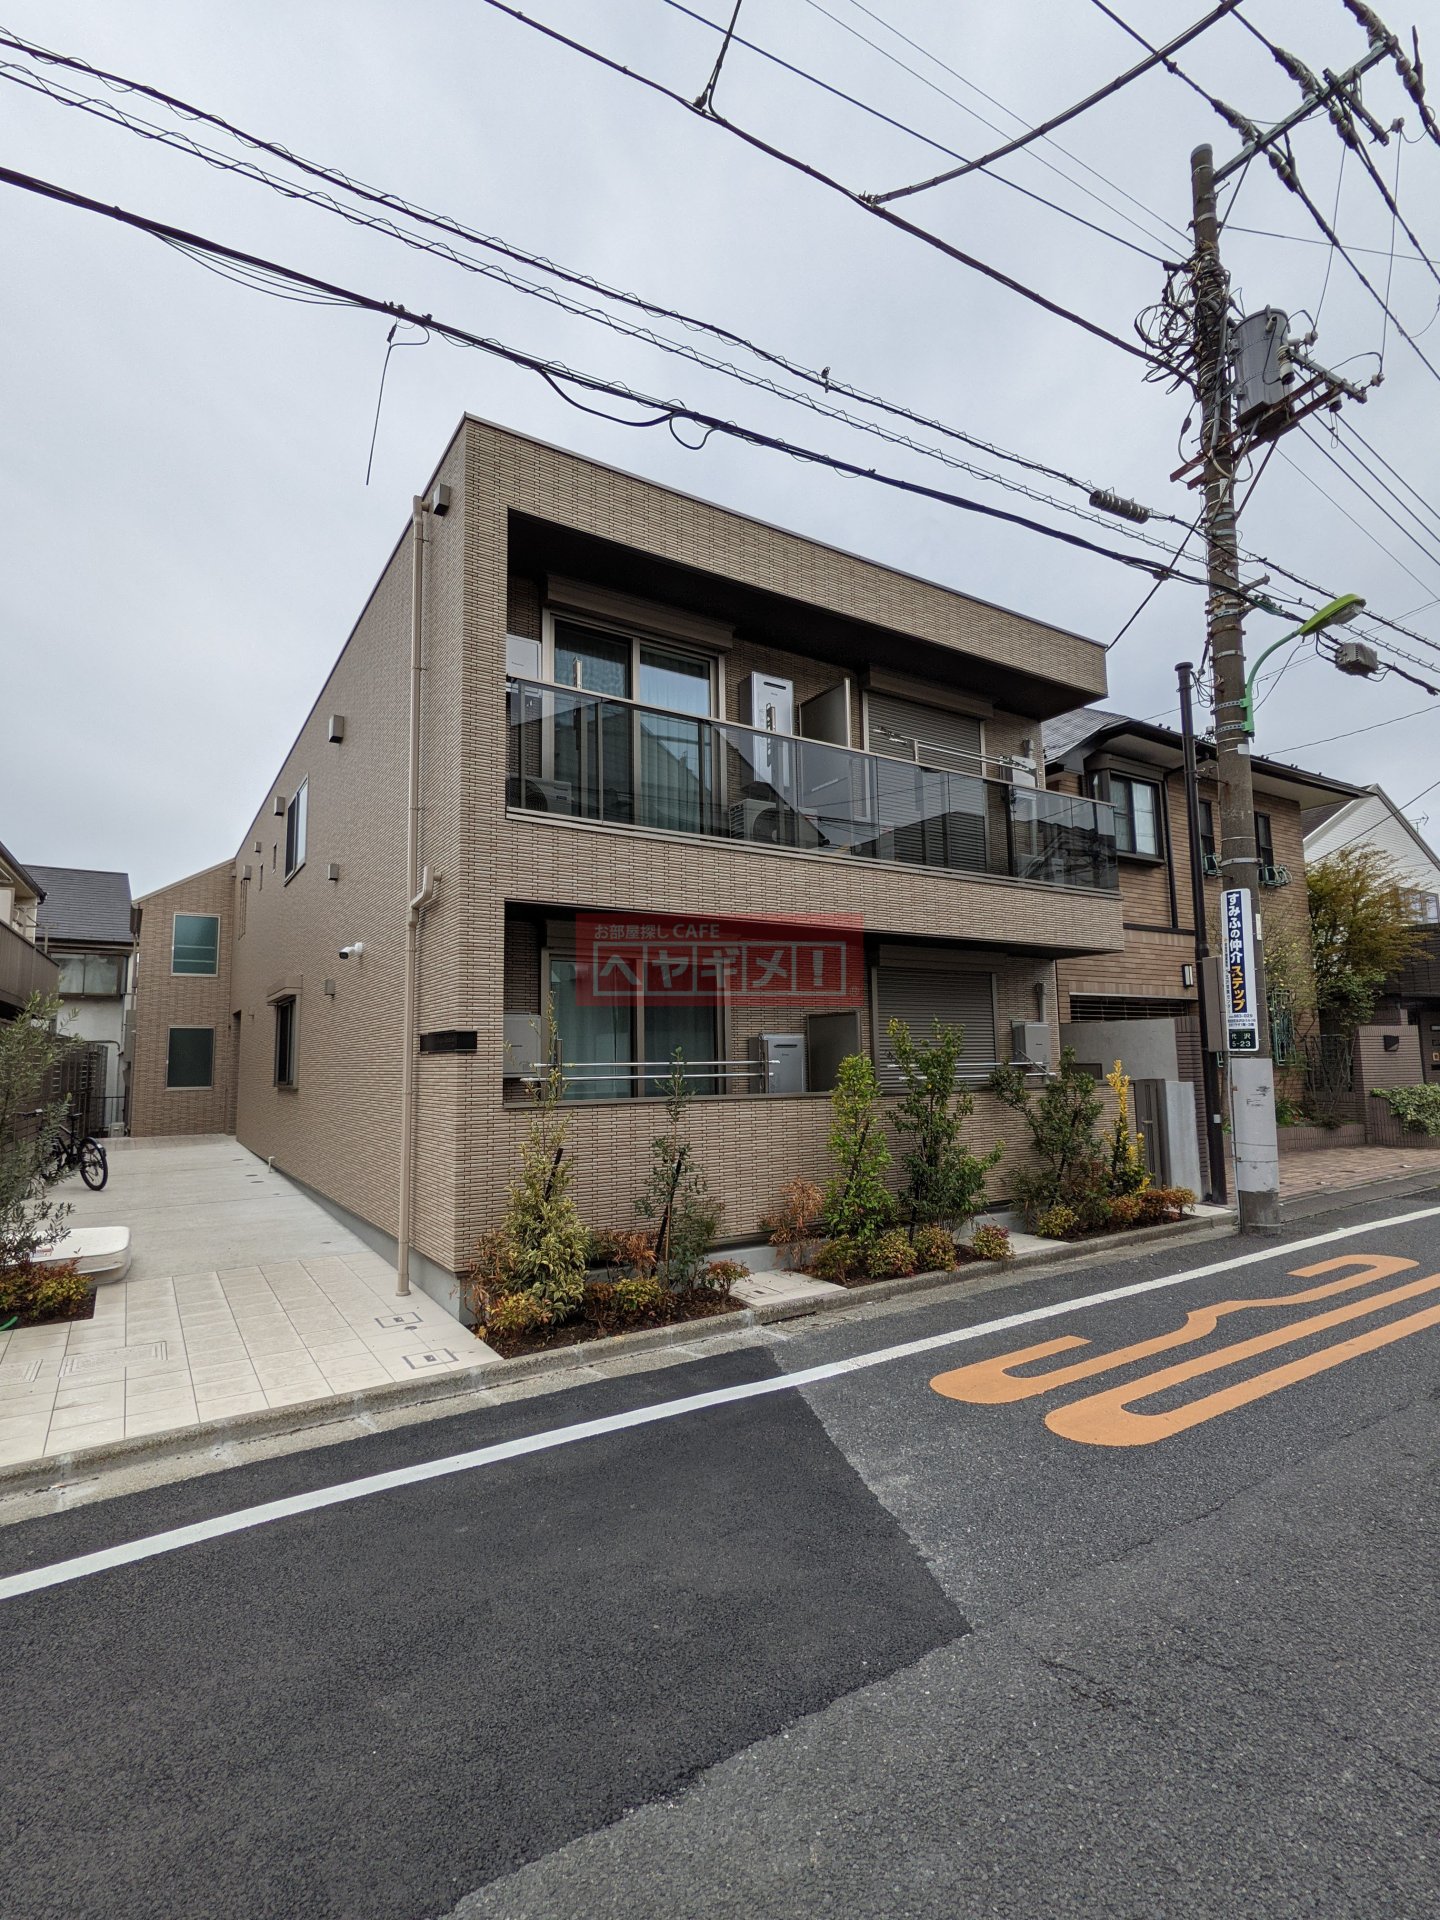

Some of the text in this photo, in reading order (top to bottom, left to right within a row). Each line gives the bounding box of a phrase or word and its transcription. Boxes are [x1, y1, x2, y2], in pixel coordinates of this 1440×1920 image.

[1228, 893, 1245, 1011] すみふの仲介ステップ
